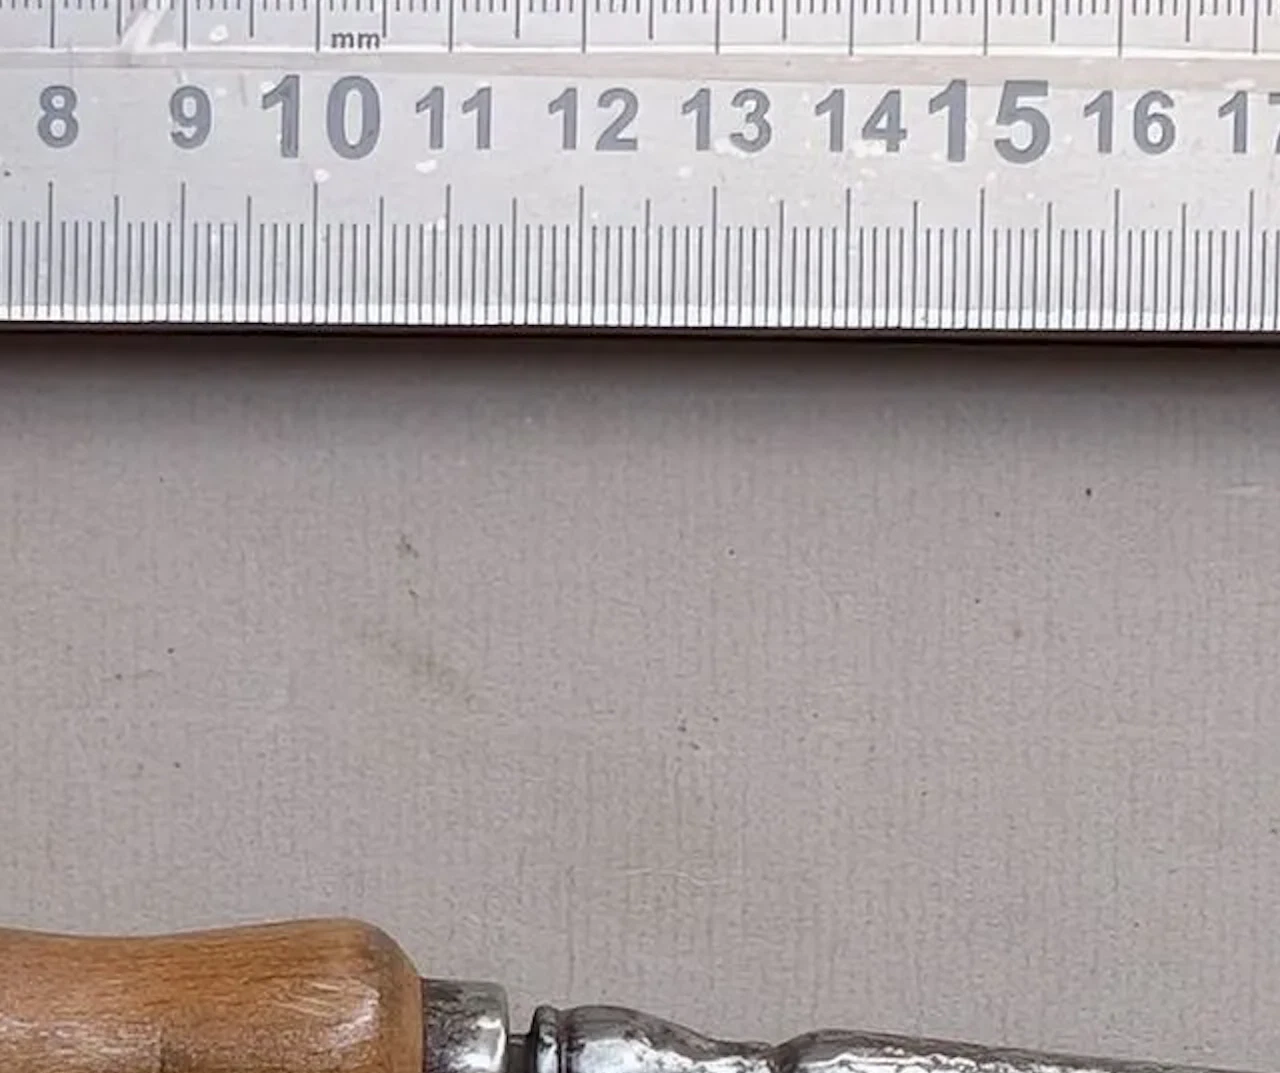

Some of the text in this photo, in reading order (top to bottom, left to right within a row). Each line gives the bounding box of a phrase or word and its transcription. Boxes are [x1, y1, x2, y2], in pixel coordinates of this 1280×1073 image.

[331, 32, 380, 49] mm
[37, 85, 79, 148] 8
[169, 85, 211, 149] 9
[261, 74, 380, 160] 10
[415, 86, 492, 150] 11
[548, 87, 638, 151] 12
[681, 88, 772, 153] 13
[815, 88, 907, 153] 14
[928, 78, 1051, 164] 15
[1083, 89, 1175, 155] 16
